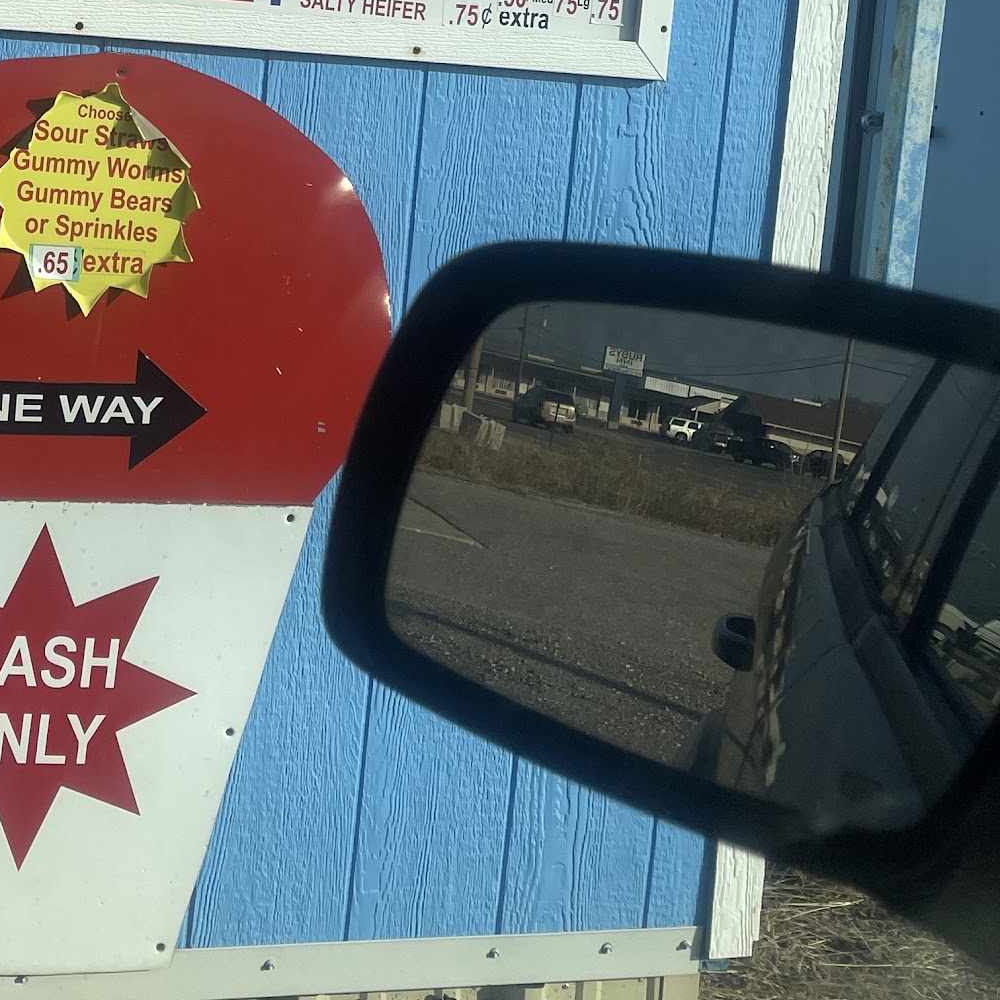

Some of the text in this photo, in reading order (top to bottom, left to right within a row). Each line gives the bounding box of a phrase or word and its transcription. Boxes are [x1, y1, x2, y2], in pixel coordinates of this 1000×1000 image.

[499, 7, 549, 29] extra
[34, 119, 88, 144] Sour
[13, 150, 183, 183] Gummy Worms
[17, 180, 173, 214] Gummy Bears
[25, 214, 158, 243] or Sprinkles
[83, 251, 144, 275] extra
[59, 394, 164, 425] WAY
